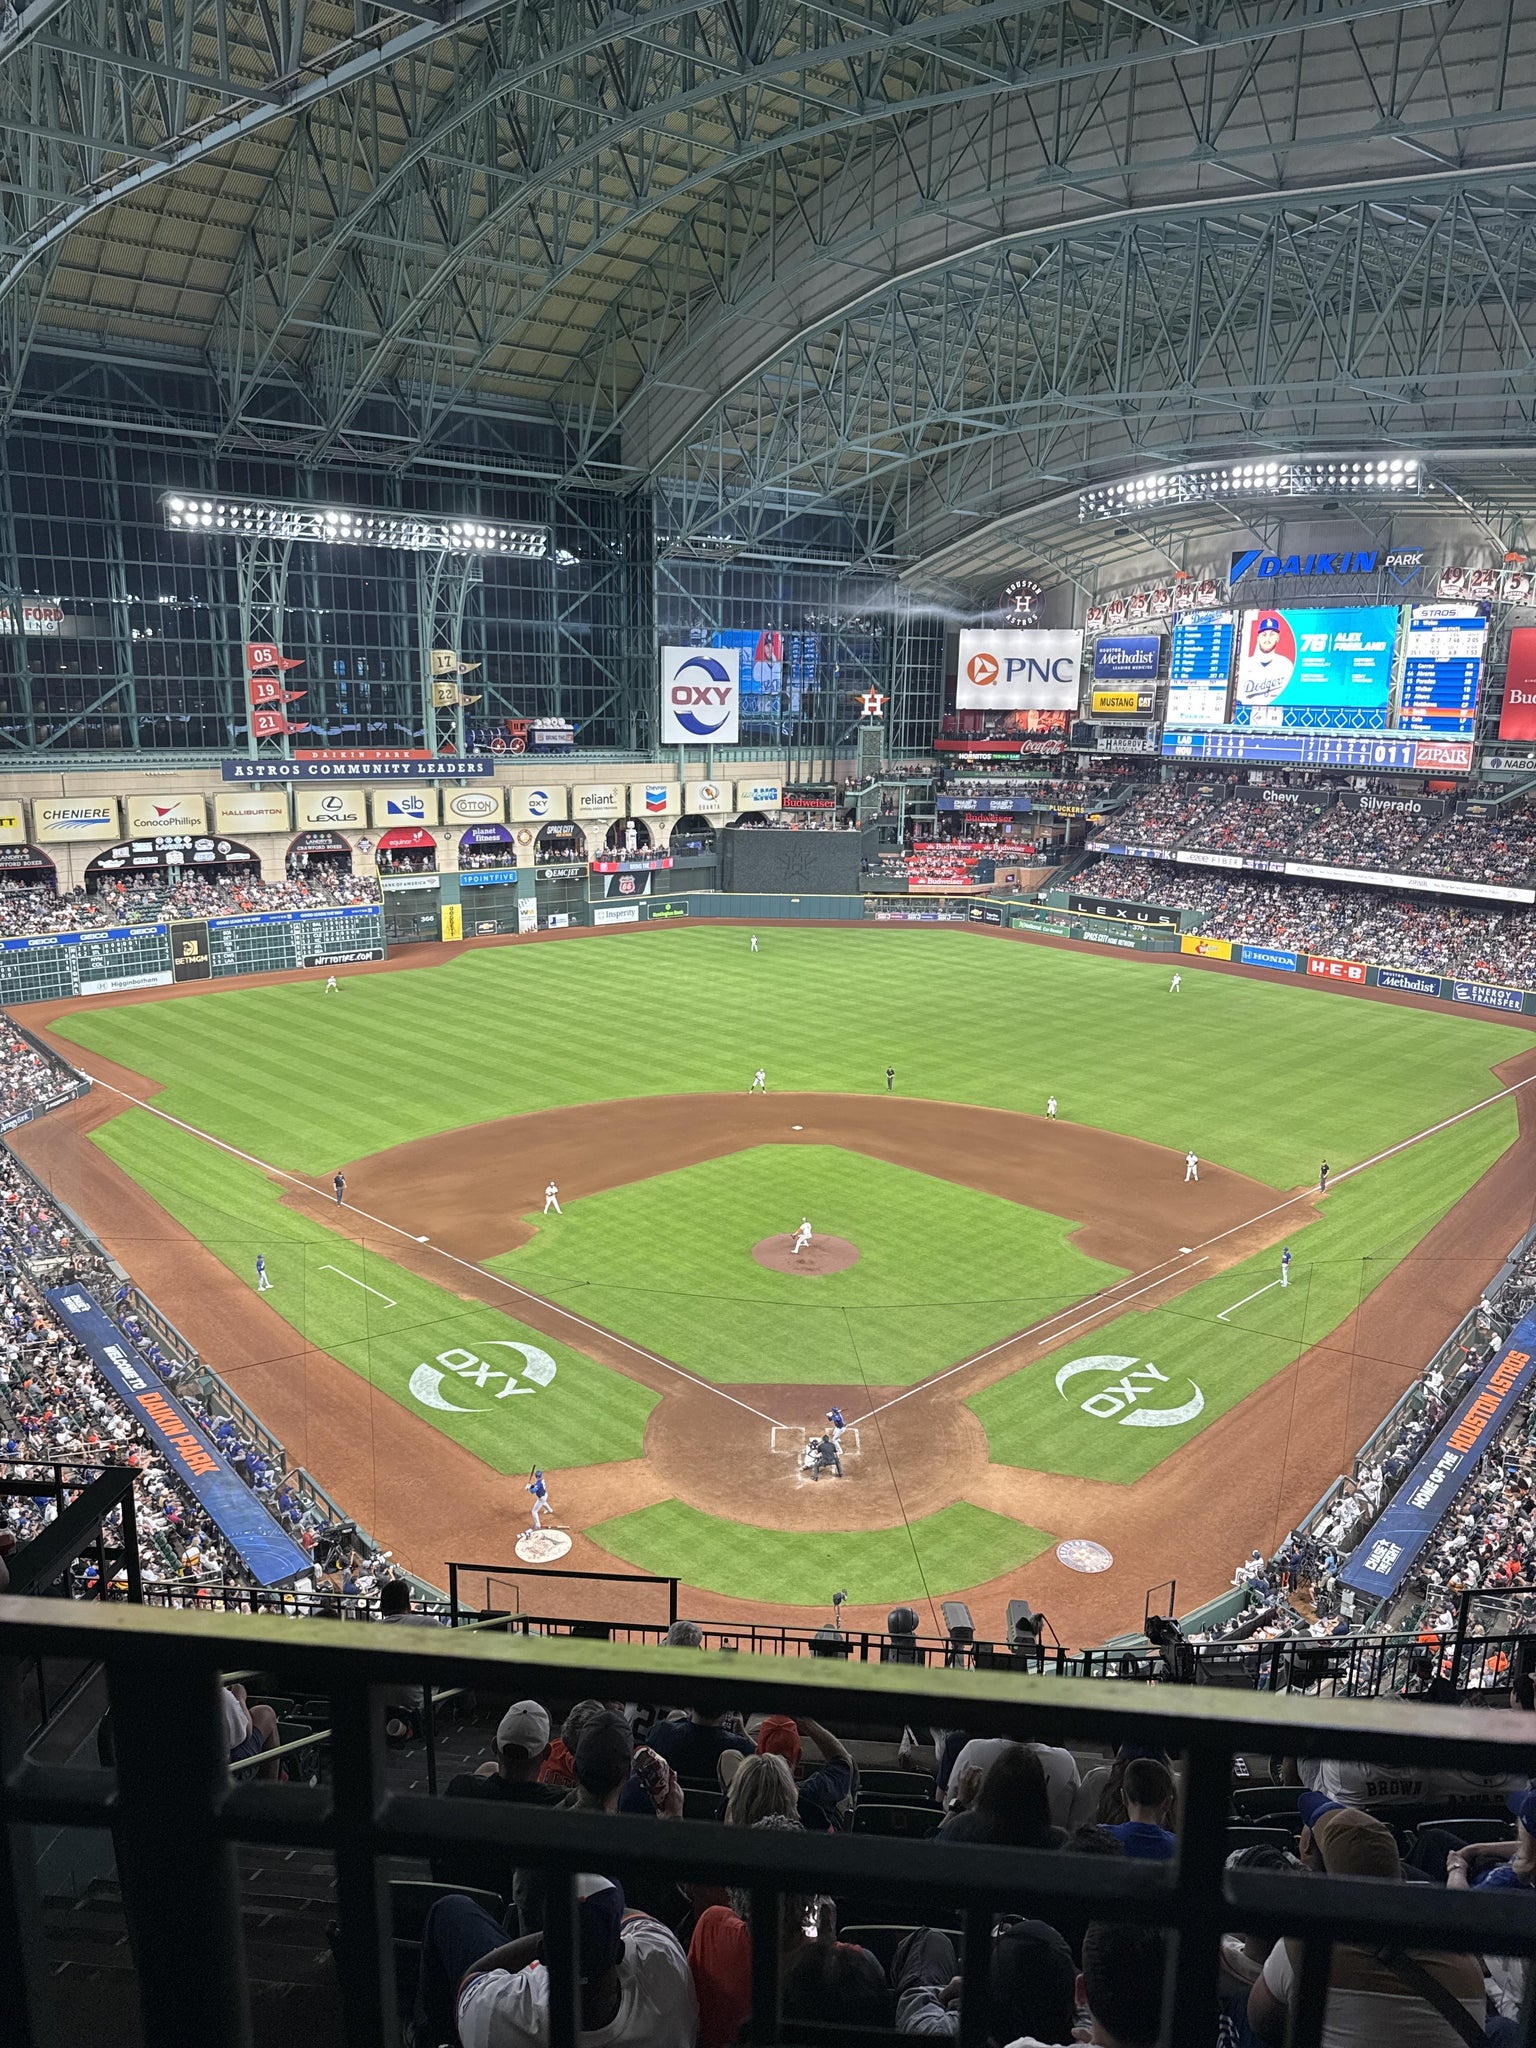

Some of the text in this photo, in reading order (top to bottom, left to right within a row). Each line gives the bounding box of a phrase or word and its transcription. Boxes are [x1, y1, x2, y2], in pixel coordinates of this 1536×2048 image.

[1257, 551, 1379, 579] DAIKIN
[1385, 553, 1424, 566] PARK
[1441, 567, 1463, 584] 49
[1472, 570, 1494, 586] 24
[1510, 573, 1521, 589] 5
[1005, 580, 1042, 596] HOUSTON
[1153, 589, 1168, 603] 33
[1015, 596, 1031, 613] H
[1109, 600, 1123, 614] 40
[1005, 613, 1038, 626] ASTROS
[1088, 607, 1101, 620] 32
[1300, 634, 1328, 652] 76
[1334, 633, 1362, 641] ALEX
[254, 649, 272, 662] 05
[437, 656, 451, 668] 17
[1099, 651, 1153, 665] Methodist
[1004, 658, 1074, 683] PNC
[258, 684, 274, 696] 19
[438, 689, 452, 699] 22
[1244, 677, 1285, 698] Dodgers
[671, 686, 732, 706] OXY
[1100, 697, 1152, 707] MUSTANG CAT
[861, 694, 884, 715] H
[259, 716, 275, 728] 21
[1106, 740, 1147, 751] HARGROVE
[1177, 736, 1192, 745] LAD
[1309, 742, 1314, 750] 7
[1324, 742, 1329, 750] 9
[1361, 744, 1366, 752] 4
[959, 752, 992, 760] HORNITOS
[1175, 747, 1192, 755] HOU
[1228, 748, 1232, 756] 0
[1238, 749, 1243, 757] 0
[1323, 753, 1328, 761] 3
[1360, 755, 1365, 763] 3
[1375, 745, 1410, 763] 0 1 1
[1417, 749, 1468, 764] ZIPAIR
[234, 763, 484, 776] ASTROS COMMUNITY LEADERS
[581, 793, 614, 805] reliant
[754, 788, 777, 801] LNG
[1263, 790, 1298, 802] Chevy
[402, 795, 424, 810] slb
[457, 799, 491, 812] COTTON
[783, 799, 835, 808] Budweiser
[1050, 805, 1085, 813] PLUCKERS
[1360, 797, 1421, 813] Silverado
[43, 808, 110, 820] CHENIERE
[307, 814, 358, 822] LEXUS
[965, 813, 1013, 822] Budweiser
[134, 817, 201, 828] ConocoPhillips
[472, 827, 496, 836] planet
[547, 825, 575, 834] SPACE CITY
[475, 833, 501, 842] fitness
[993, 844, 1025, 852] Budweiser
[1165, 850, 1171, 858] K
[1190, 854, 1238, 865] ezee FIBER
[552, 867, 579, 877] EMCJET
[464, 874, 514, 884] 1POINTFIVE
[420, 915, 434, 923] 366
[606, 909, 635, 918] Insperity
[1078, 903, 1170, 924] LEXUS
[1083, 931, 1096, 941] SPACE
[1096, 933, 1109, 943] CITY
[175, 955, 208, 966] BETMGM
[315, 952, 372, 966] NITTOTIRE.COM
[1253, 952, 1295, 966] HONDA
[111, 976, 158, 988] Higginbotham
[1382, 976, 1434, 993] Methodist
[1472, 986, 1511, 999] ENERGY
[1471, 994, 1519, 1009] TRANSFER
[103, 1345, 147, 1390] WELCOME TO
[436, 1348, 536, 1399] OXY
[1081, 1362, 1170, 1418] OXY
[1446, 1350, 1531, 1453] HOUSTON ASTROS
[135, 1391, 221, 1477] DAIKIN PARK
[1411, 1451, 1459, 1510] HOME OF THE
[1366, 1780, 1422, 1797] BROWN
